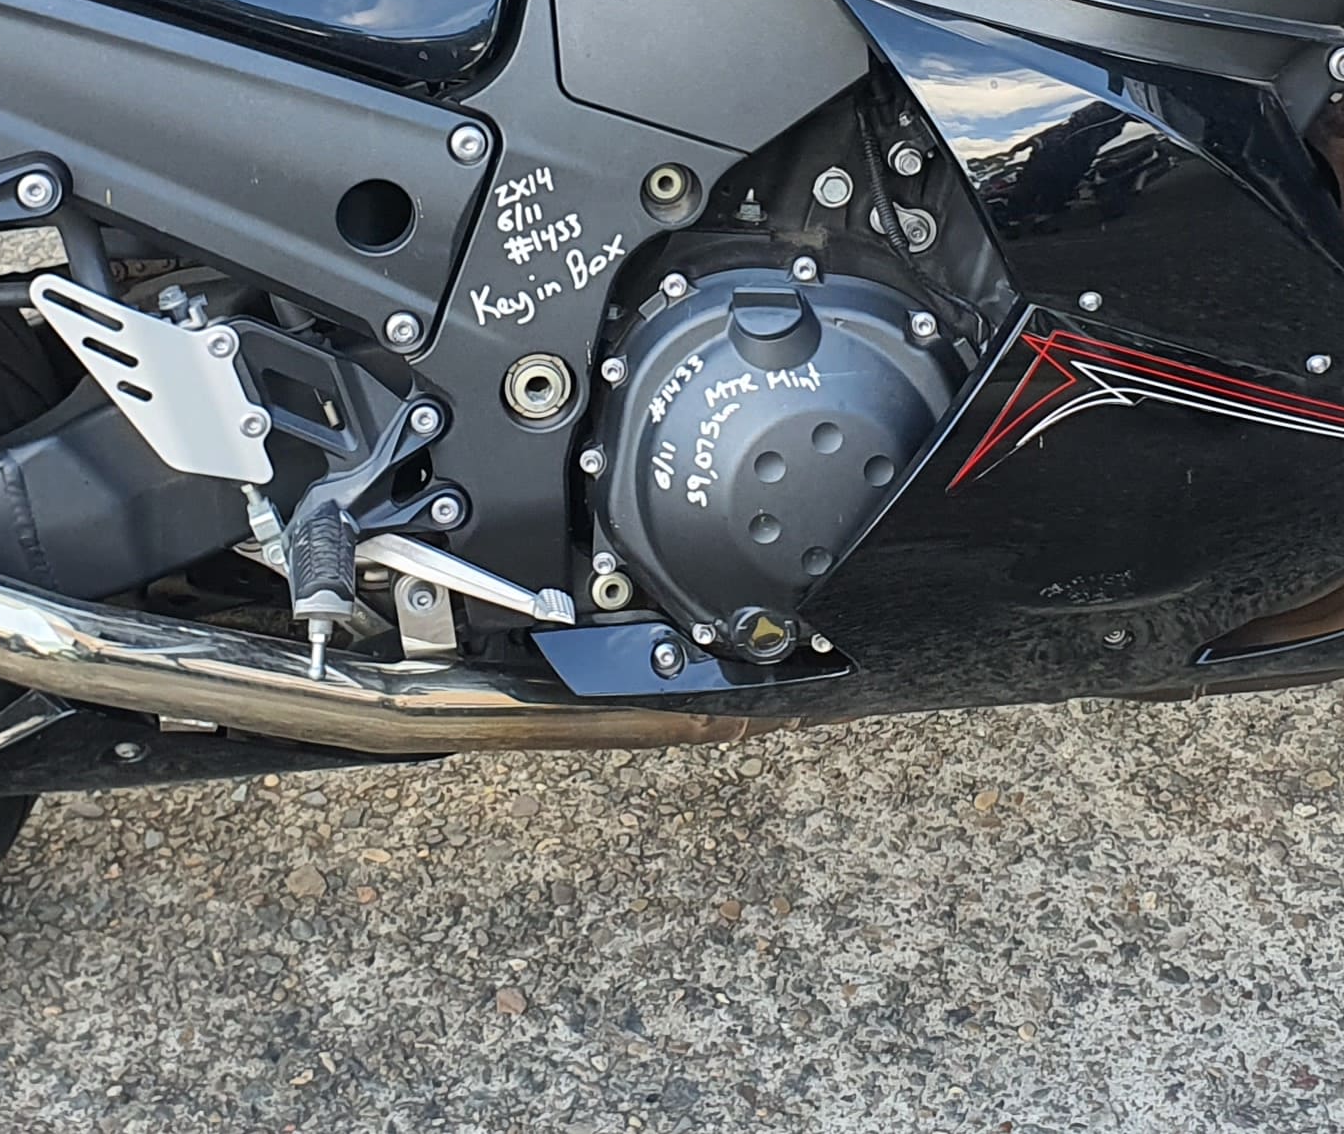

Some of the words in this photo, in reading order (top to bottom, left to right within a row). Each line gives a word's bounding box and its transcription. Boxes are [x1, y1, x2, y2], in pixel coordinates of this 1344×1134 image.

[494, 166, 555, 208] ZX14
[497, 202, 543, 232] 6/11
[470, 285, 535, 326] Key
[529, 274, 562, 301] in
[565, 233, 626, 291] Box
[648, 354, 704, 423] #1433
[766, 362, 821, 392] Mint
[651, 441, 677, 490] 6/11
